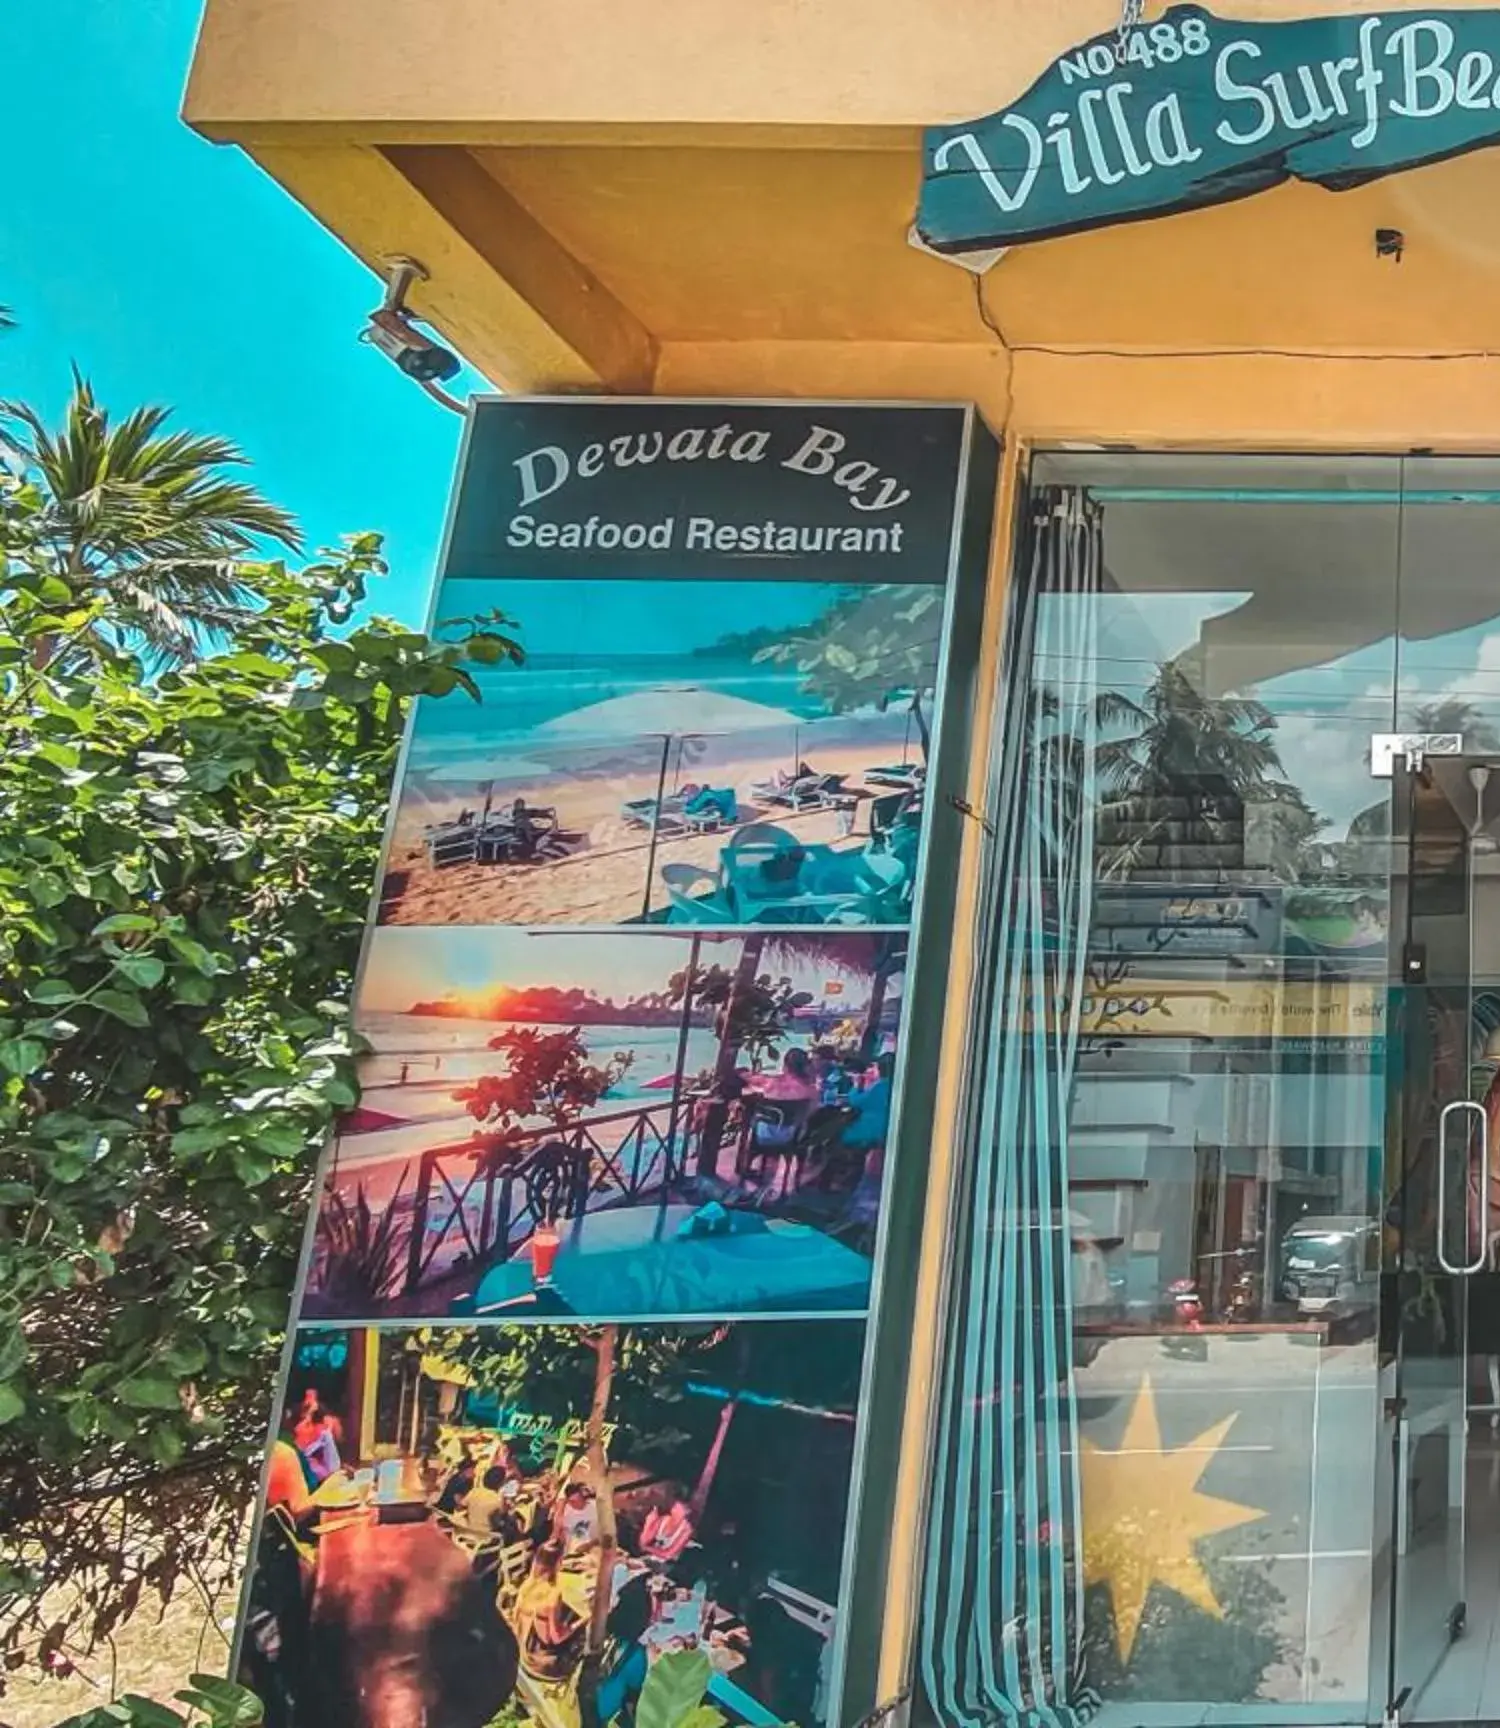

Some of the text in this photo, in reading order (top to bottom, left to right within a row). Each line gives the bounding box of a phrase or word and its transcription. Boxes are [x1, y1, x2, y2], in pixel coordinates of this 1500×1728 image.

[1127, 18, 1211, 69] 488
[934, 81, 1203, 213] Villa
[1215, 17, 1382, 148] Surf
[512, 422, 912, 512] Dewata Bay
[506, 514, 904, 554] Seafood Restaurant
